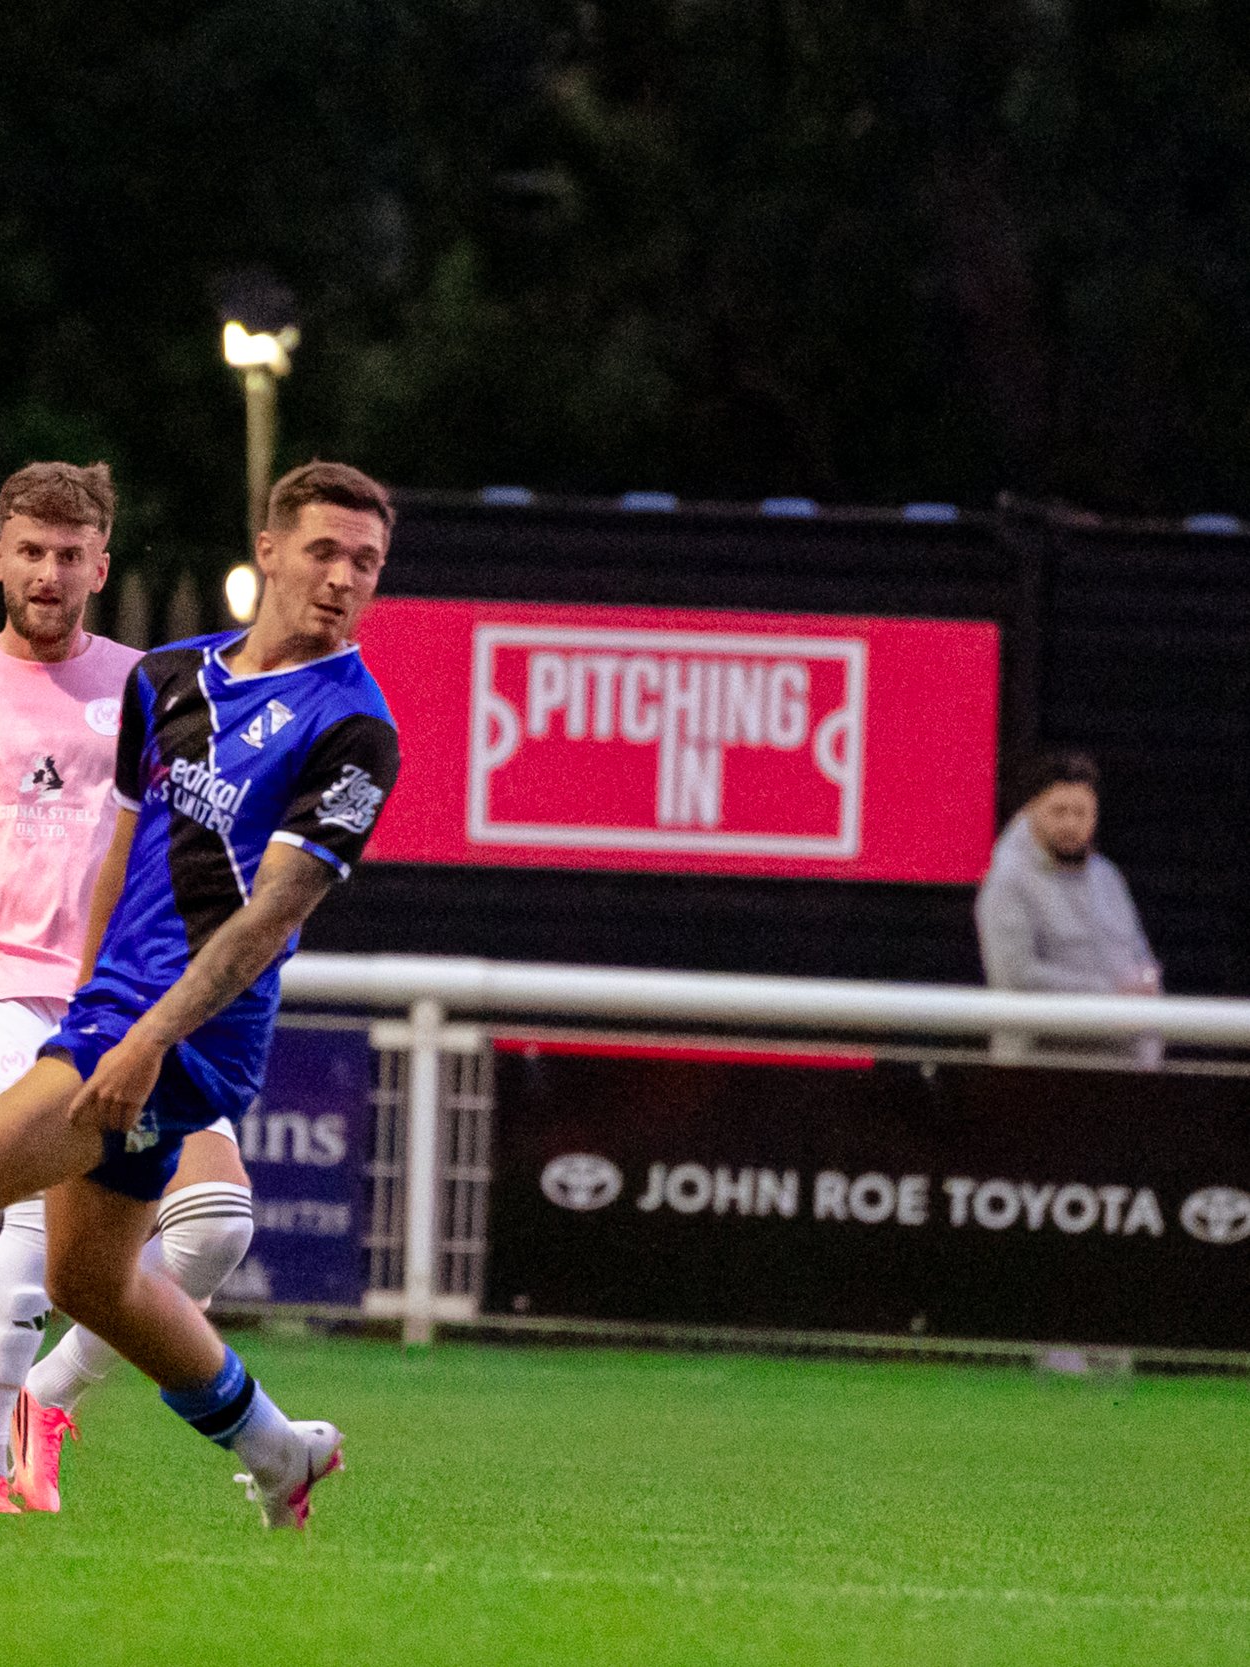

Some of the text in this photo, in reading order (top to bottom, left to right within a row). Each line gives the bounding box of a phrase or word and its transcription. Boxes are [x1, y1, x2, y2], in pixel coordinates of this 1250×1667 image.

[526, 652, 809, 749] PITCHING
[658, 742, 721, 827] IN
[16, 823, 36, 838] UK
[637, 1162, 1164, 1239] JOHN ROE TOYOTA
